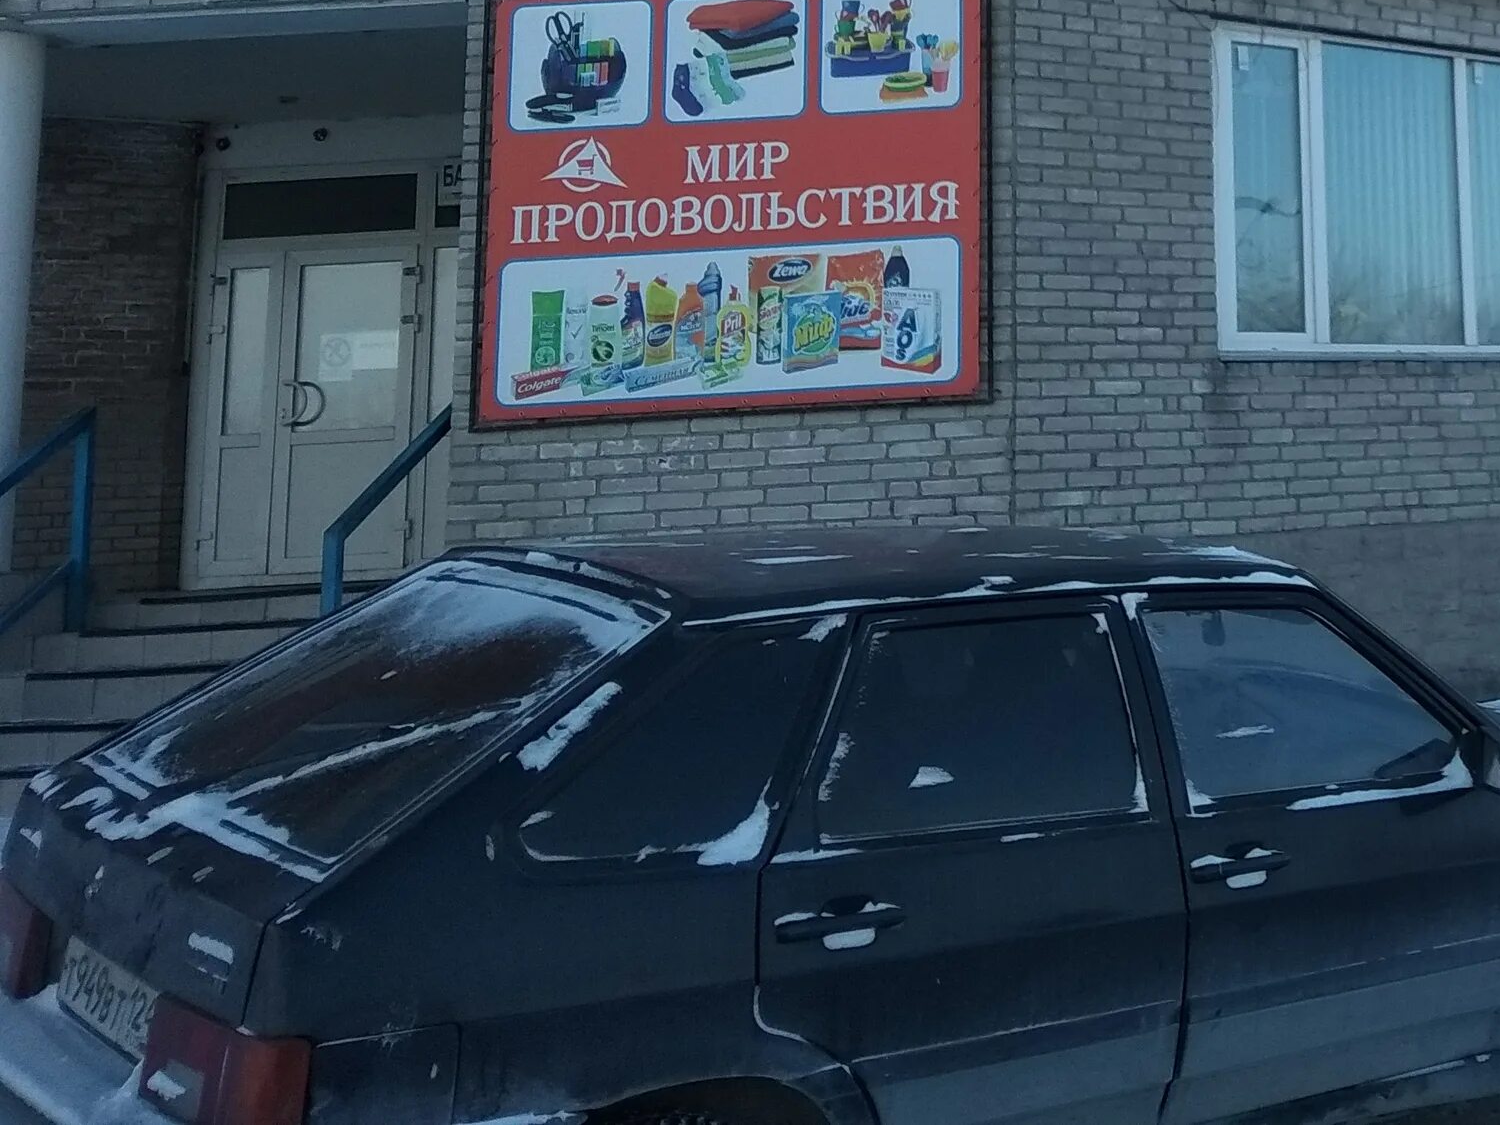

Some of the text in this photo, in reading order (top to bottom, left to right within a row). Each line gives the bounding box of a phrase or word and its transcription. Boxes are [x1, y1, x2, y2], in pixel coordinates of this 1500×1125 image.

[683, 141, 790, 185] МИР
[510, 180, 960, 245] ПРОДОВОЛЬСТВИЯ
[772, 261, 809, 278] Zewa
[723, 314, 743, 334] Pril
[517, 374, 563, 393] Colgate
